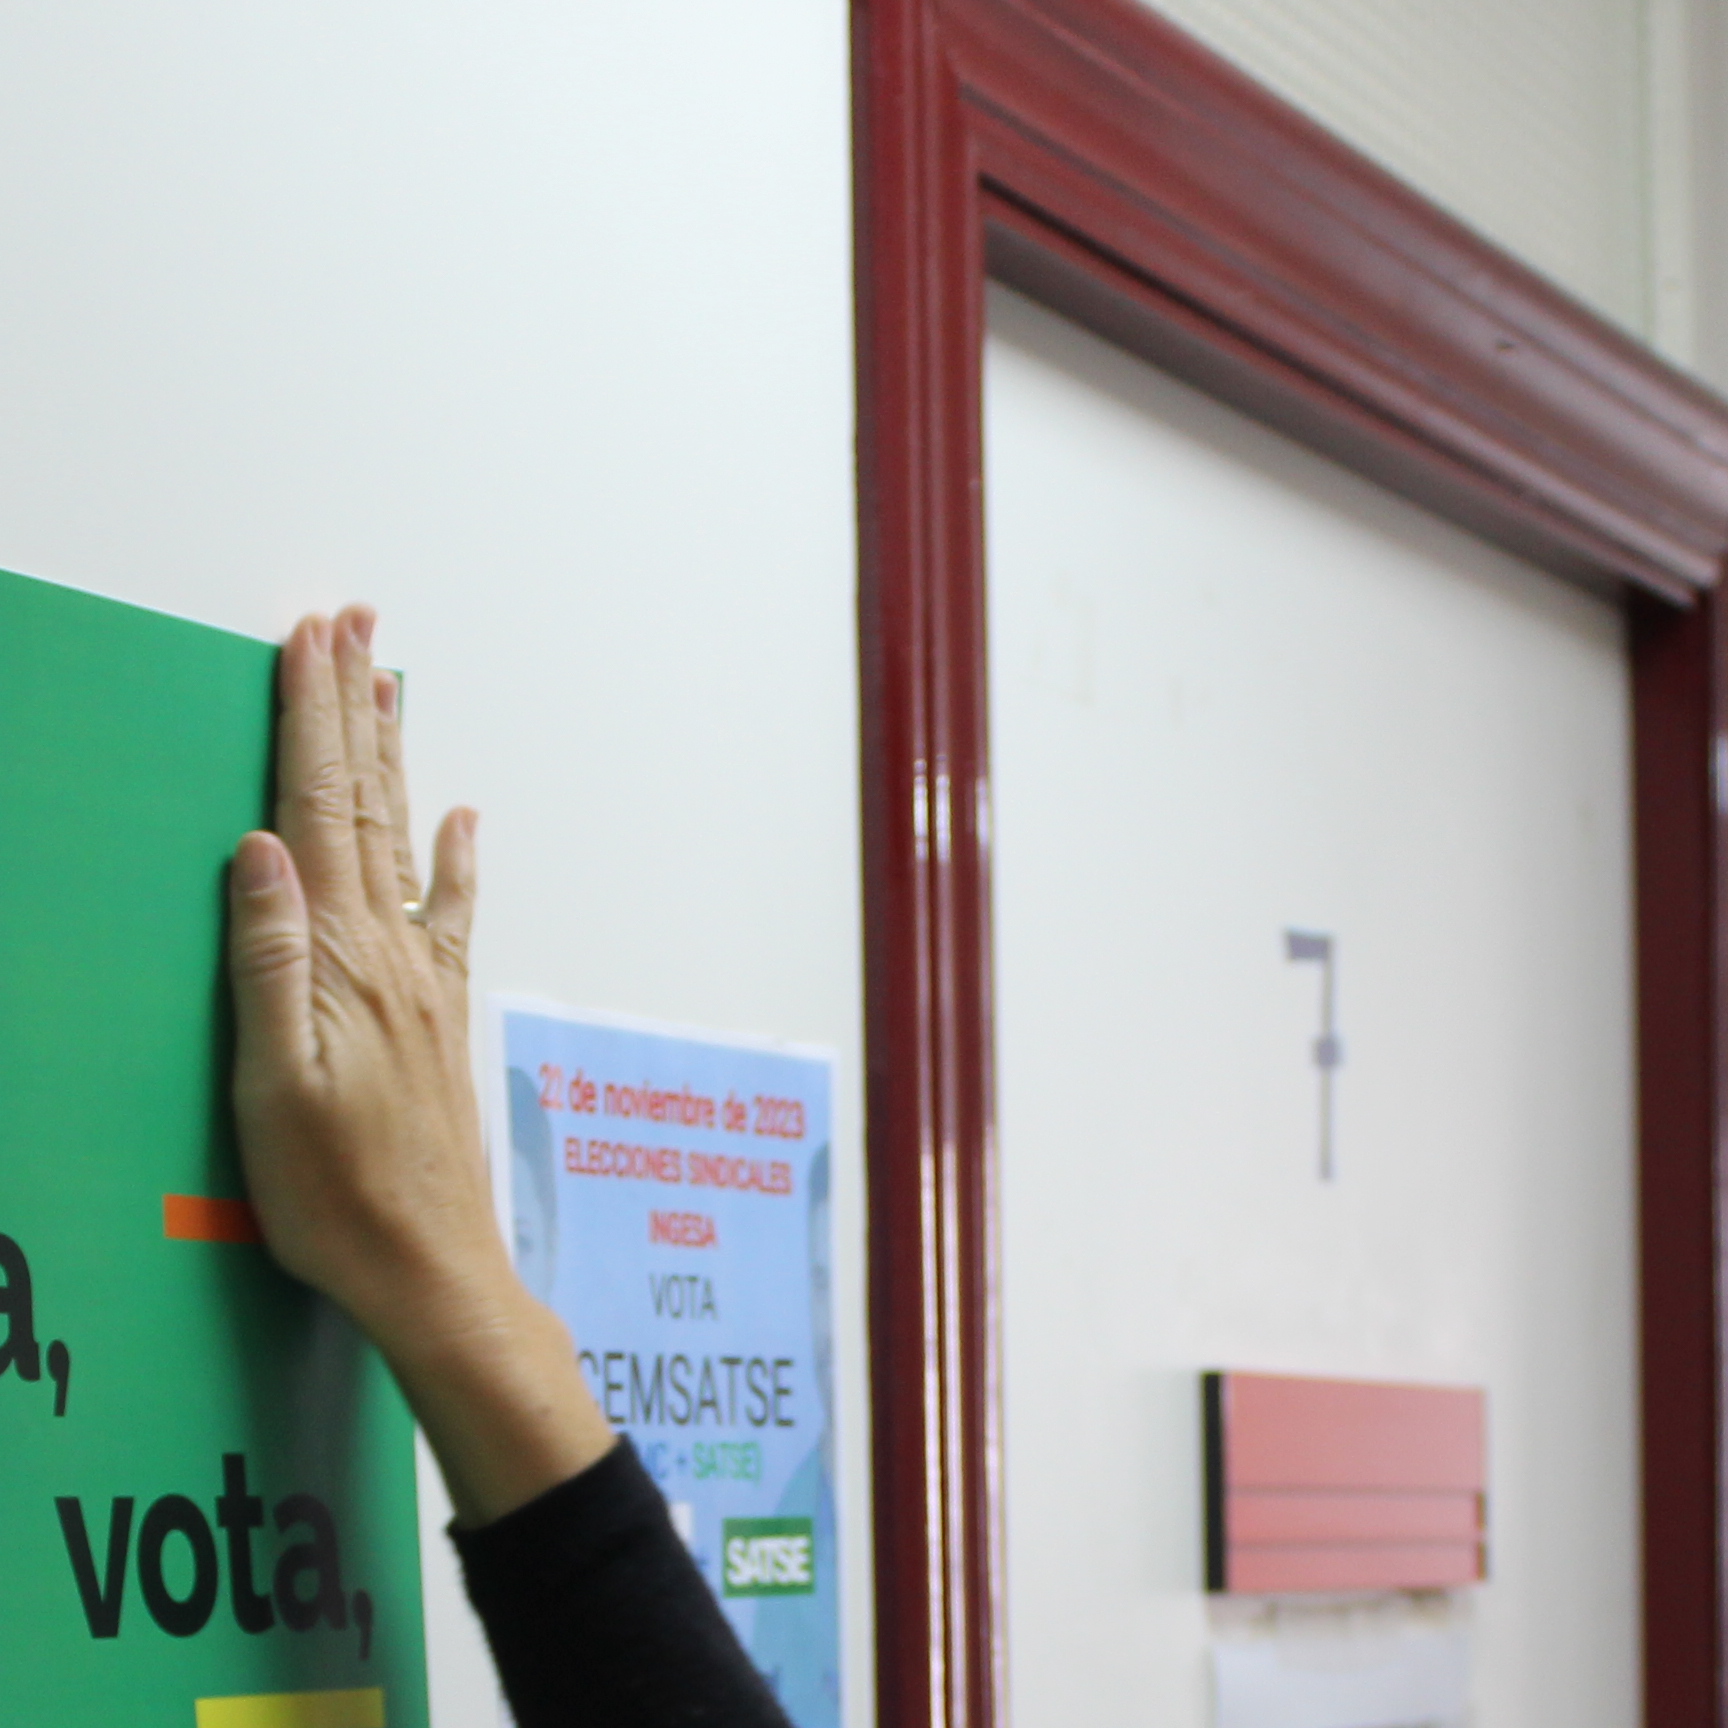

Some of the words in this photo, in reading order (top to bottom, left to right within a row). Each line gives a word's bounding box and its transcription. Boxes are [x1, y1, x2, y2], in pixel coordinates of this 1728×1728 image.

[568, 1067, 597, 1115] de
[604, 1078, 716, 1129] noviembre
[723, 1089, 749, 1133] de
[753, 1094, 807, 1142] 2023
[565, 1136, 683, 1185] ELECCIONES
[687, 1151, 794, 1196] SINDICALES
[647, 1209, 718, 1249] INGESA
[648, 1272, 718, 1321] VOTA
[54, 1453, 374, 1661] vota,
[726, 1534, 812, 1587] SATSE
